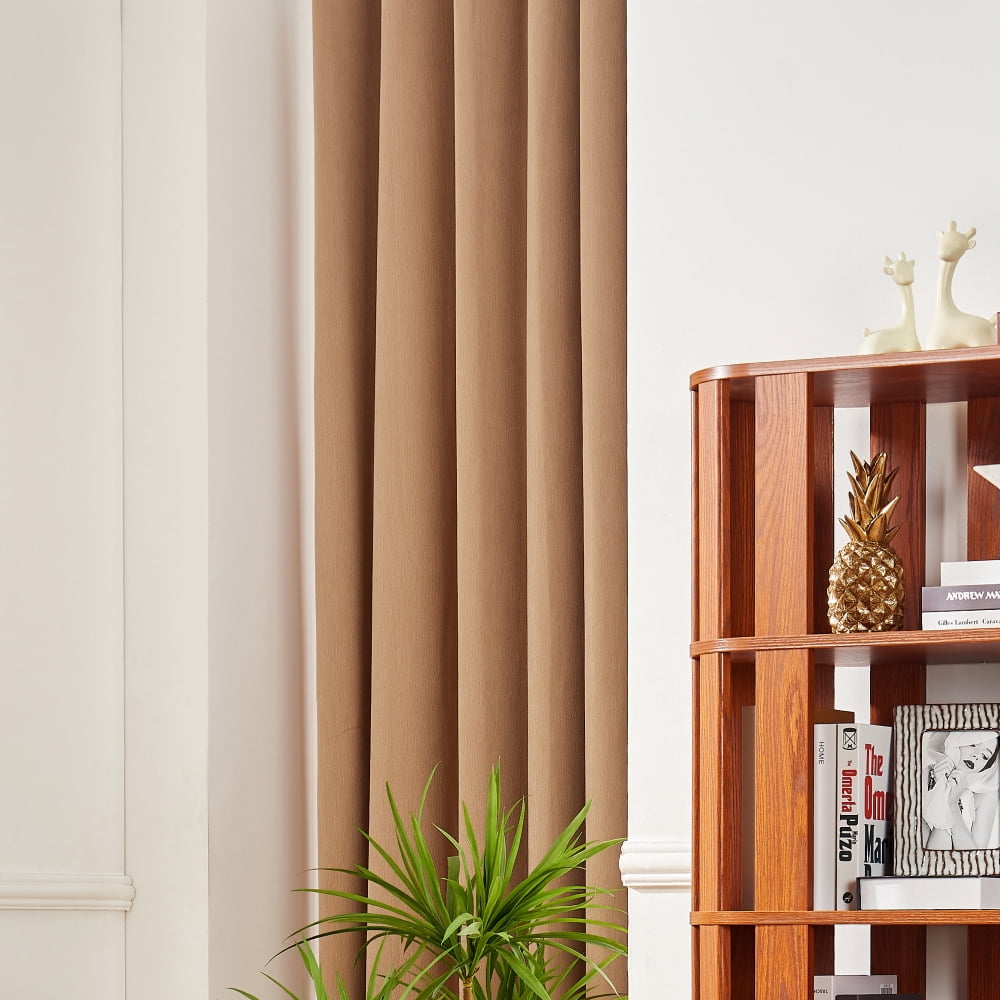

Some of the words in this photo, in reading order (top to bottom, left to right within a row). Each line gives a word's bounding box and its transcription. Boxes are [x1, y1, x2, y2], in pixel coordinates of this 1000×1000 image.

[945, 590, 984, 601] ANDREW
[864, 743, 884, 777] The
[839, 814, 859, 862] Puzo
